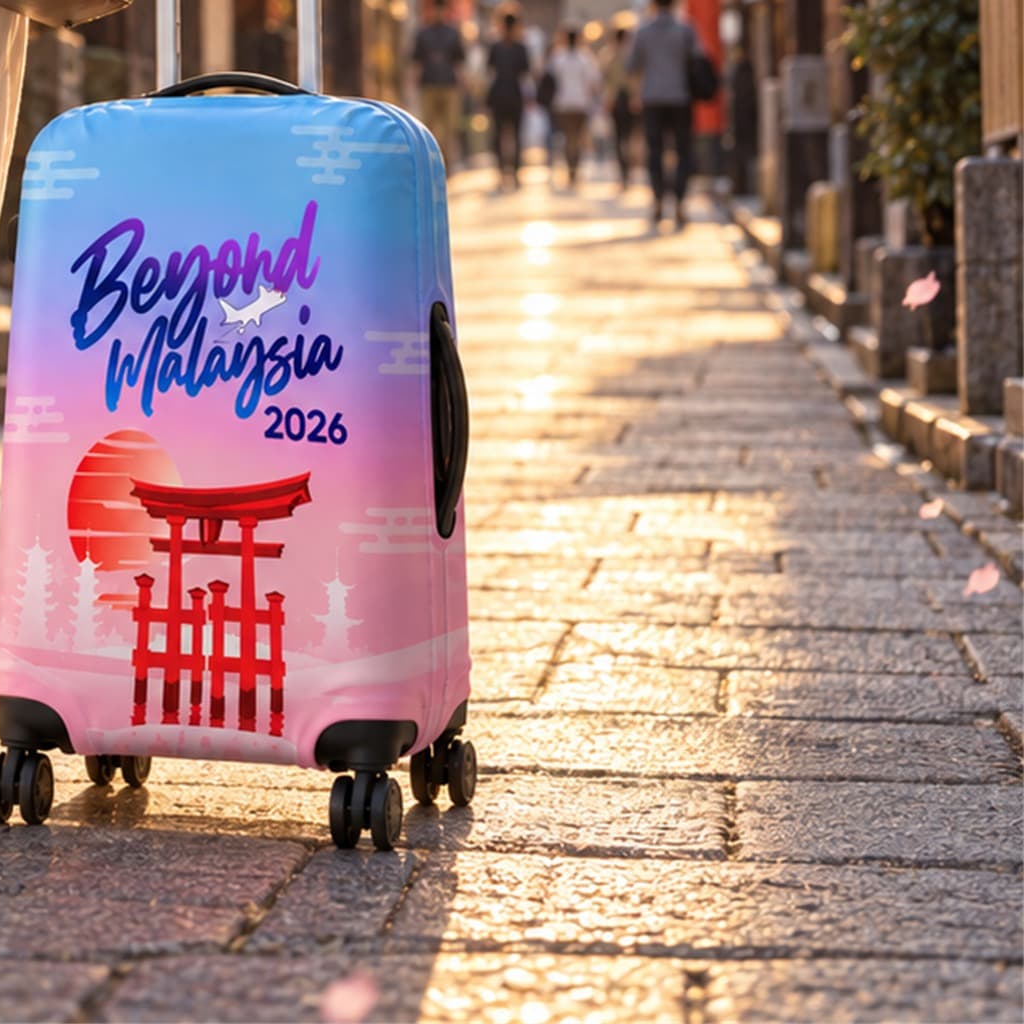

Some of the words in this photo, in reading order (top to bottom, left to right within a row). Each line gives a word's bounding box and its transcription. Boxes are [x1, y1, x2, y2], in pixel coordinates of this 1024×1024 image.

[70, 200, 320, 351] Beyond
[105, 304, 344, 419] Malaysia
[264, 405, 347, 444] 2026
